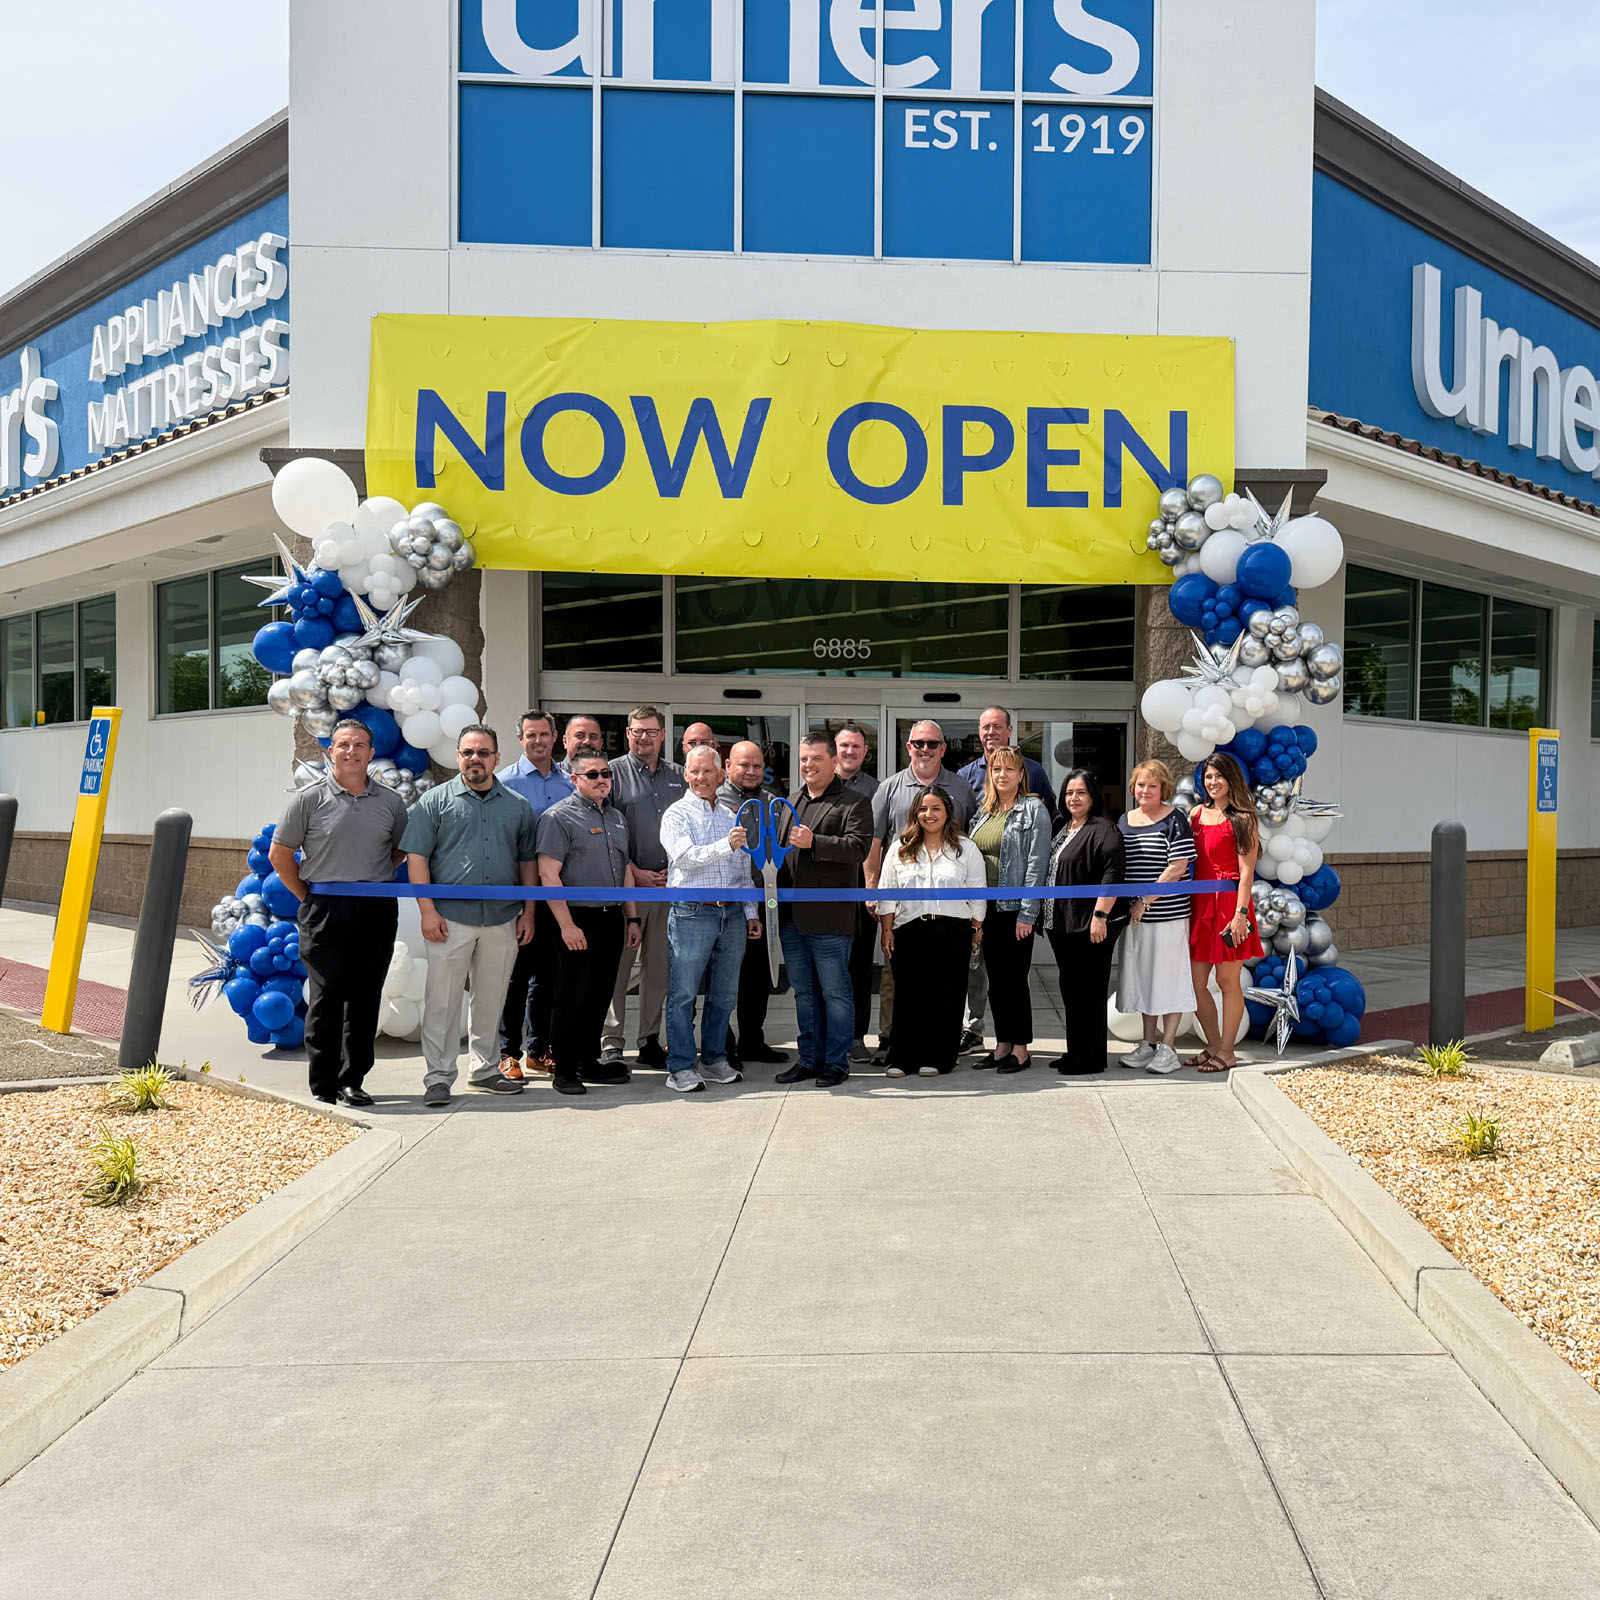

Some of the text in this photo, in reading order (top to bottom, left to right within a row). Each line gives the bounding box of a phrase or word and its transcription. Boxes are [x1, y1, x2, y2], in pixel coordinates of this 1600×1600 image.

[904, 109, 1146, 155] EST. 1919
[88, 232, 288, 382] APPLIANCES
[88, 318, 289, 454] MATTRESSES
[1411, 262, 1600, 481] Urne
[415, 389, 1189, 508] NOW OPEN
[812, 638, 872, 660] 6885
[83, 758, 104, 773] PARKING
[84, 775, 98, 790] ONLY
